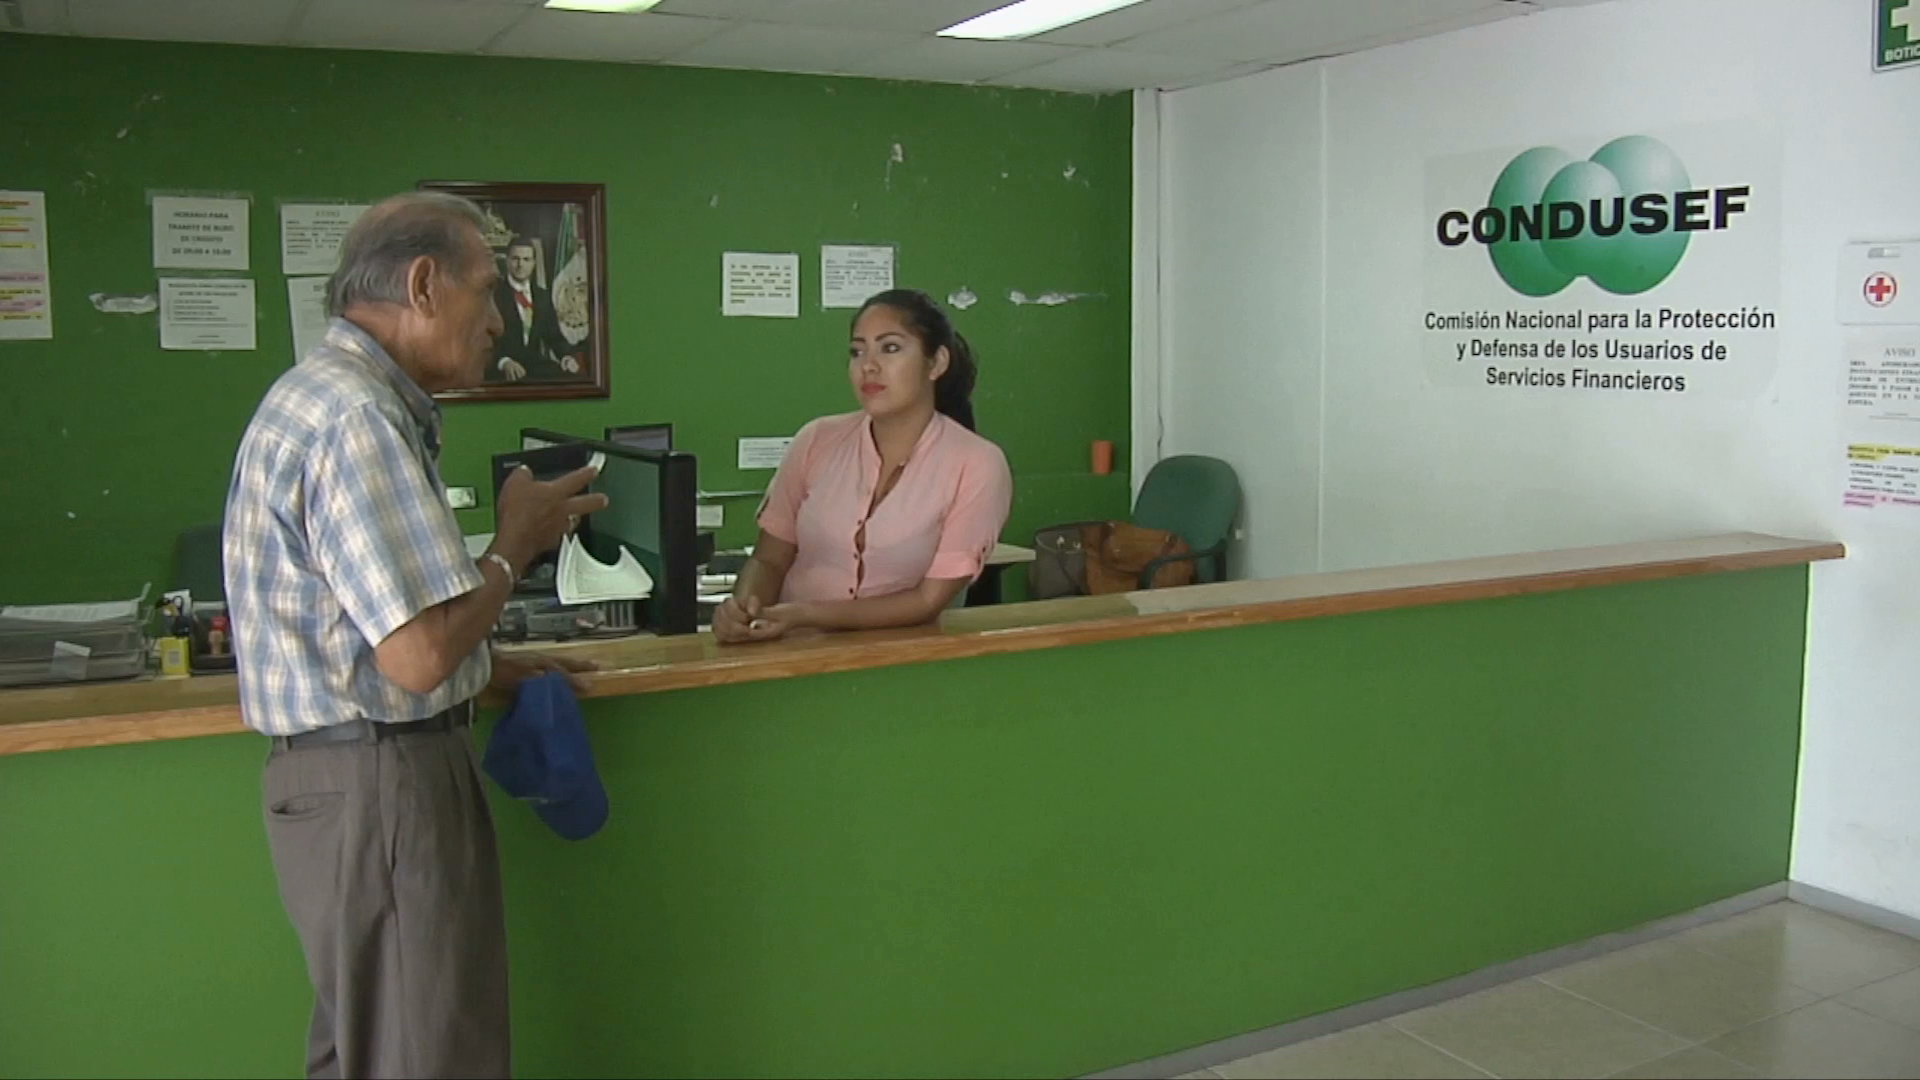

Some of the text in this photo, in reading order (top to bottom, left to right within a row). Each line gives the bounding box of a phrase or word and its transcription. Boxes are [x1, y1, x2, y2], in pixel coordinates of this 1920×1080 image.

[1437, 186, 1749, 246] CONDUSEF
[1425, 306, 1775, 333] Comisión Nacional para la Protección
[1456, 338, 1727, 361] y Defensa de los Usuarios de
[1486, 367, 1686, 392] Servicios Financieros
